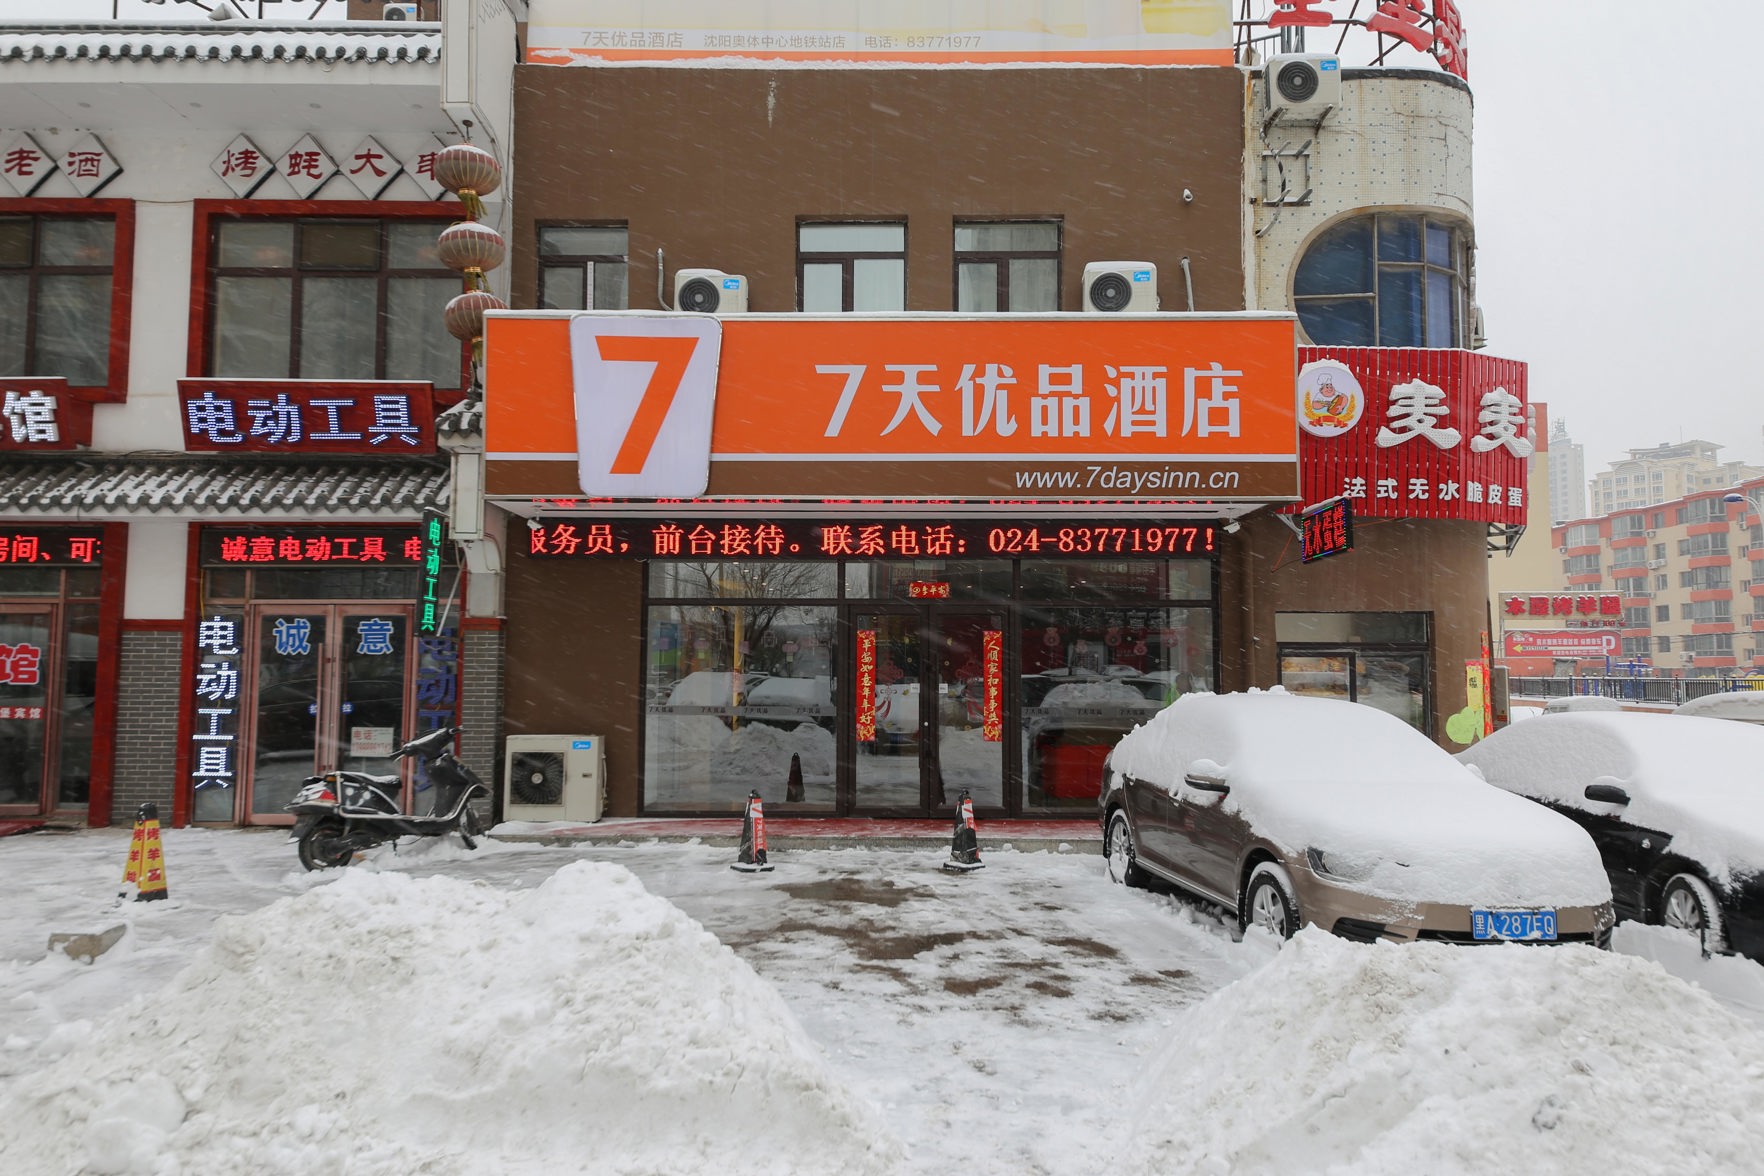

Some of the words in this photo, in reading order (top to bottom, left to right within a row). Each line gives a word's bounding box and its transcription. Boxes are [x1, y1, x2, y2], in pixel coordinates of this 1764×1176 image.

[581, 31, 684, 48] 7天优品酒店
[703, 34, 846, 48] 沈阳奥体中心地铁站店
[0, 391, 61, 443] 馆
[187, 392, 420, 446] 电动工具
[594, 336, 700, 474] 7
[814, 362, 1244, 438] 7天优品酒店
[1015, 466, 1240, 494] www.7daysinn.cn
[221, 536, 387, 562] 诚意电动工具
[421, 518, 442, 631] 电动工具
[273, 618, 312, 657] 诚
[356, 618, 395, 656] 意
[192, 615, 239, 789] 电动工具
